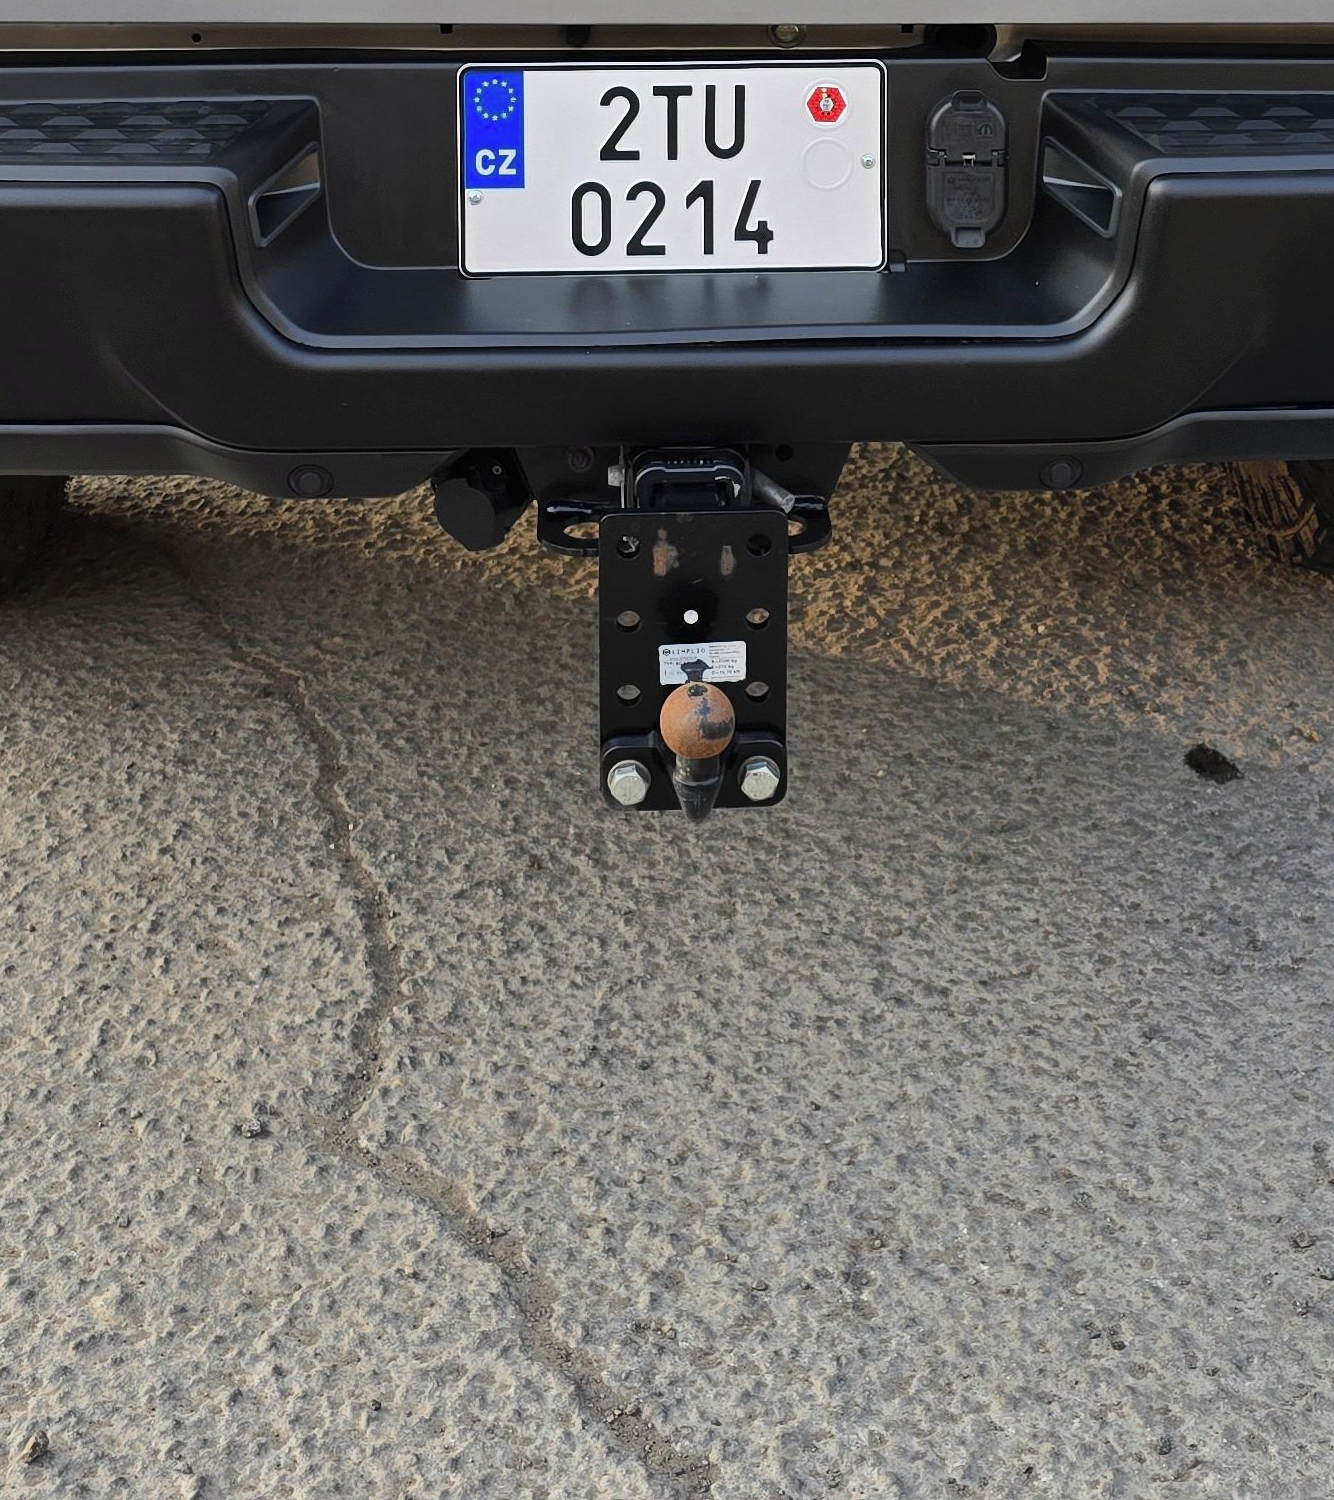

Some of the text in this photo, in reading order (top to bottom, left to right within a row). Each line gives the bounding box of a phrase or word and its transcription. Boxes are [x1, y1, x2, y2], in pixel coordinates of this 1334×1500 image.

[600, 85, 745, 160] 2TU
[476, 149, 516, 175] CZ
[572, 180, 773, 256] 0214
